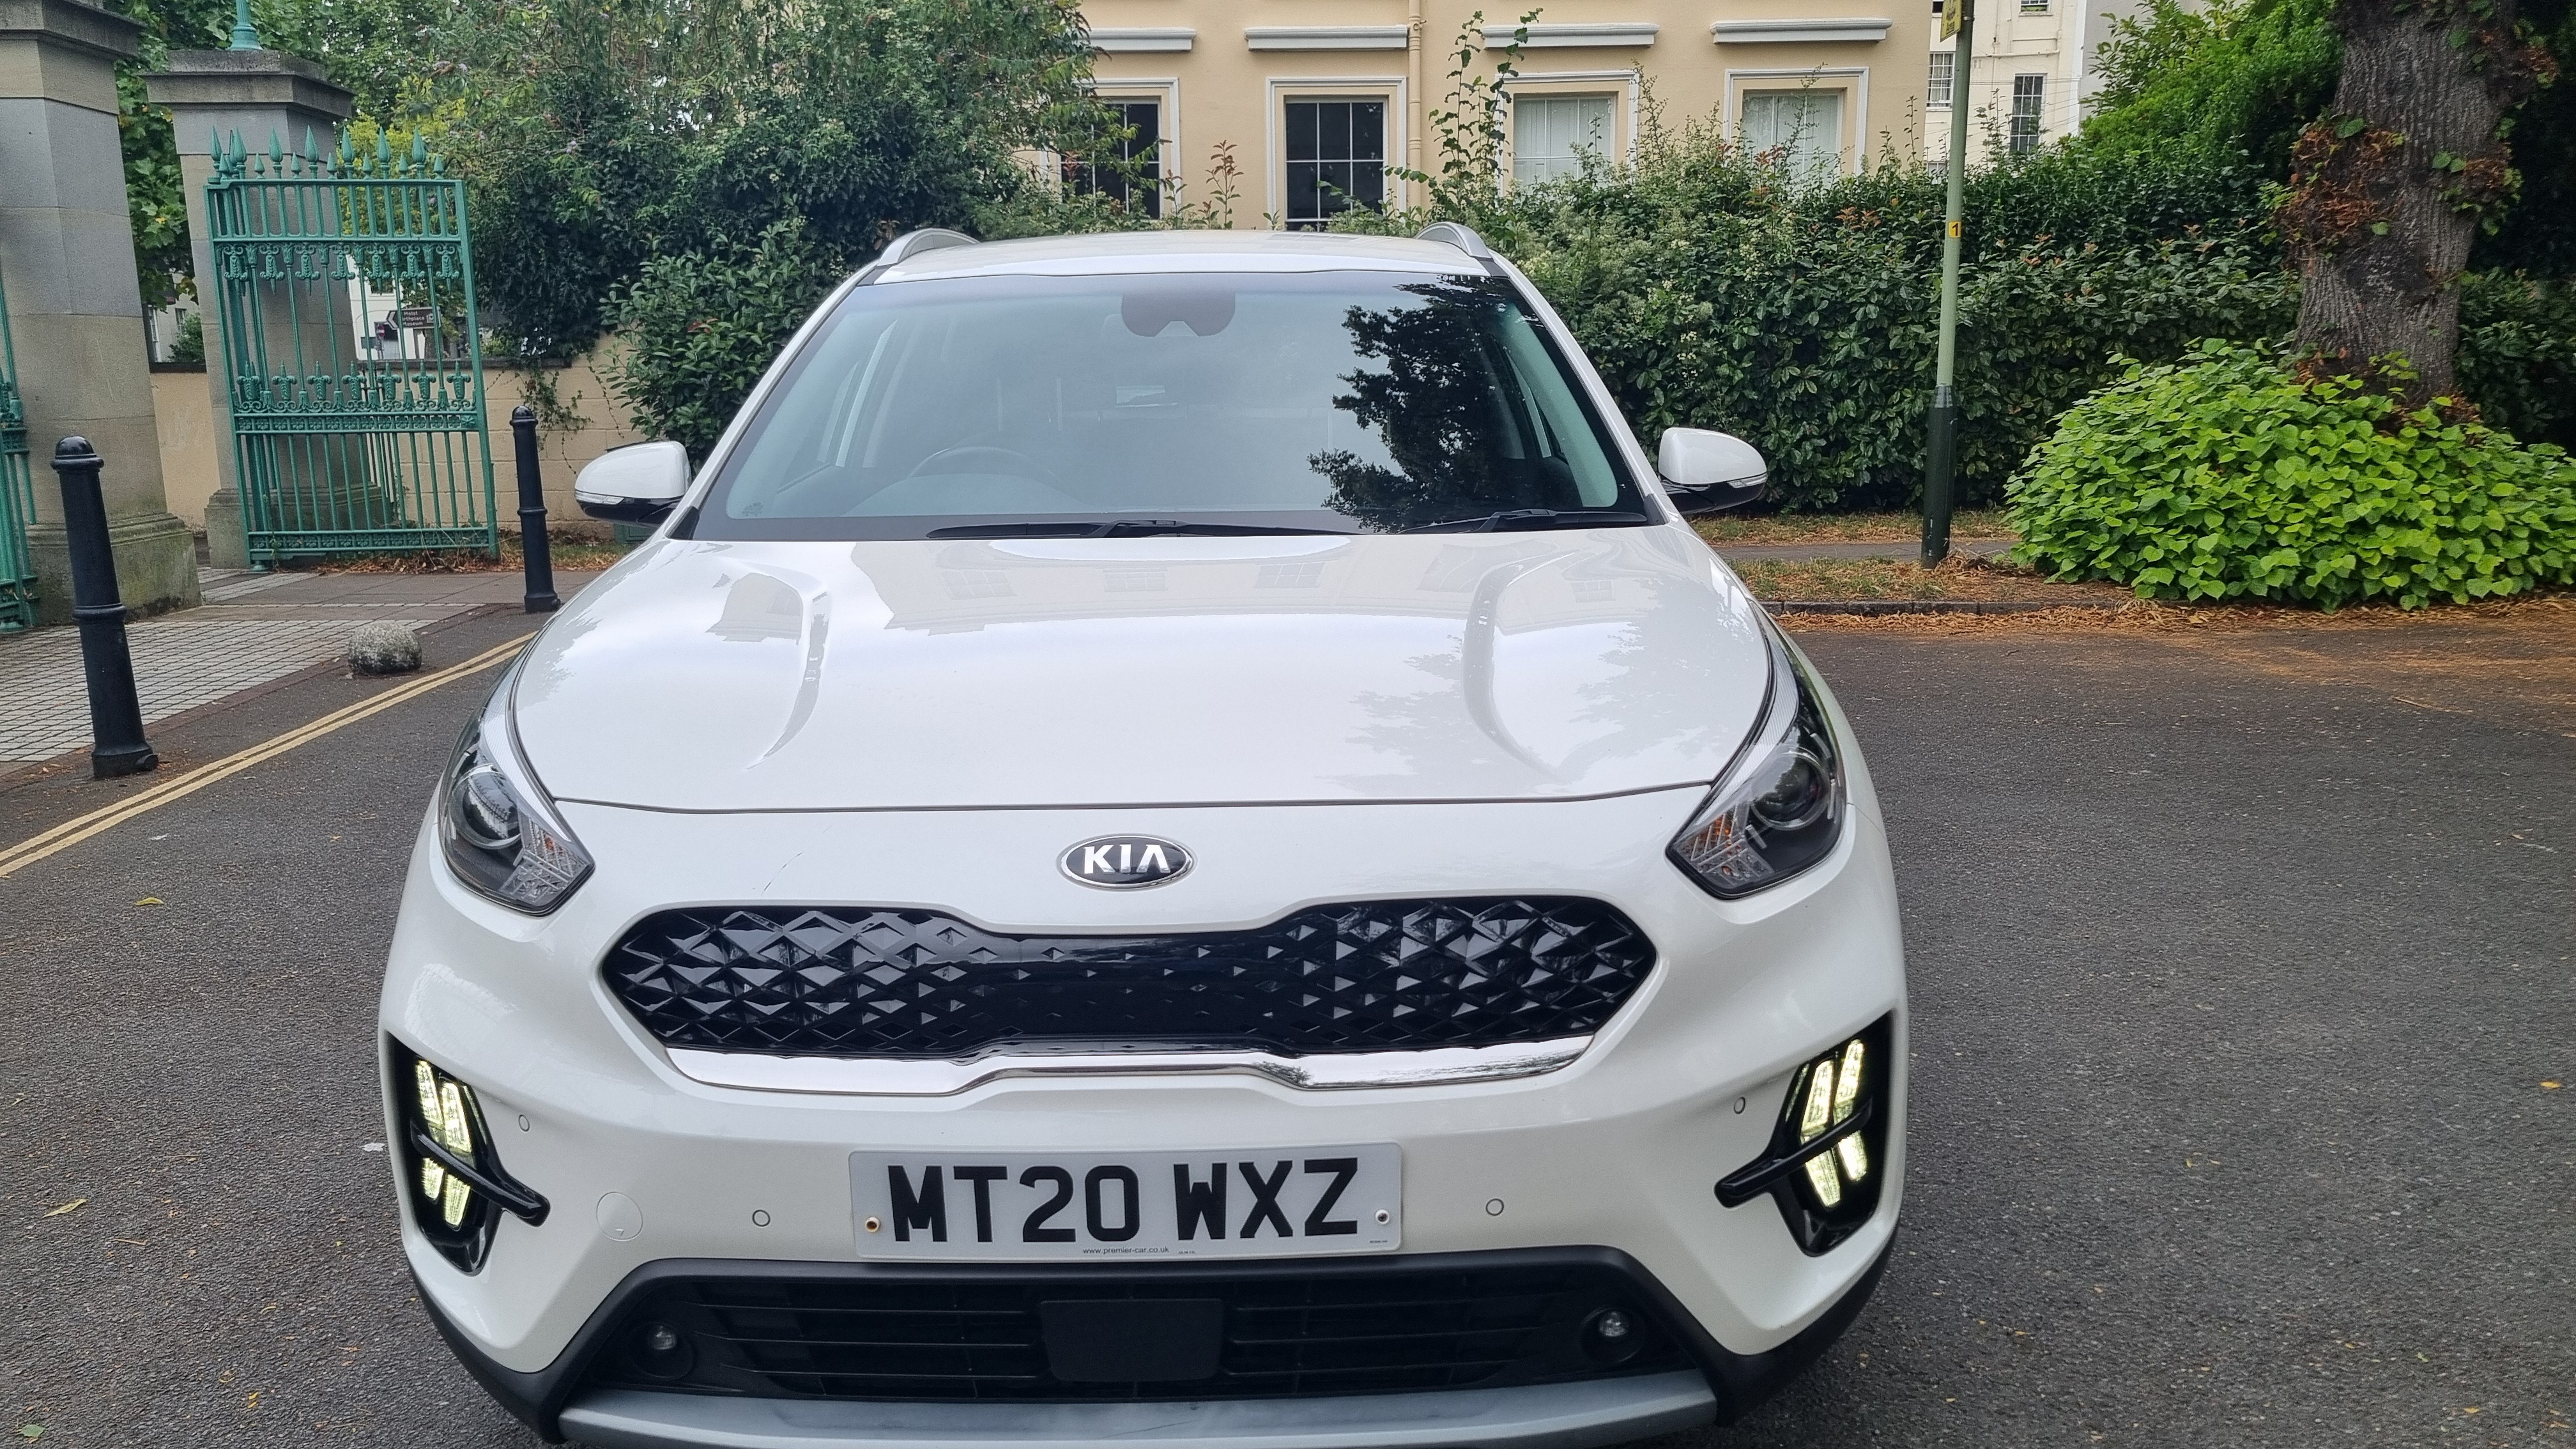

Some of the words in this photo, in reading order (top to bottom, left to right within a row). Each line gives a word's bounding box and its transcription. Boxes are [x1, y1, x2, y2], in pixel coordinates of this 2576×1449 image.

[1952, 222, 1958, 236] 1
[1084, 844, 1171, 874] KIA
[888, 1165, 1140, 1243] MT20
[1174, 1157, 1358, 1241] WXZ
